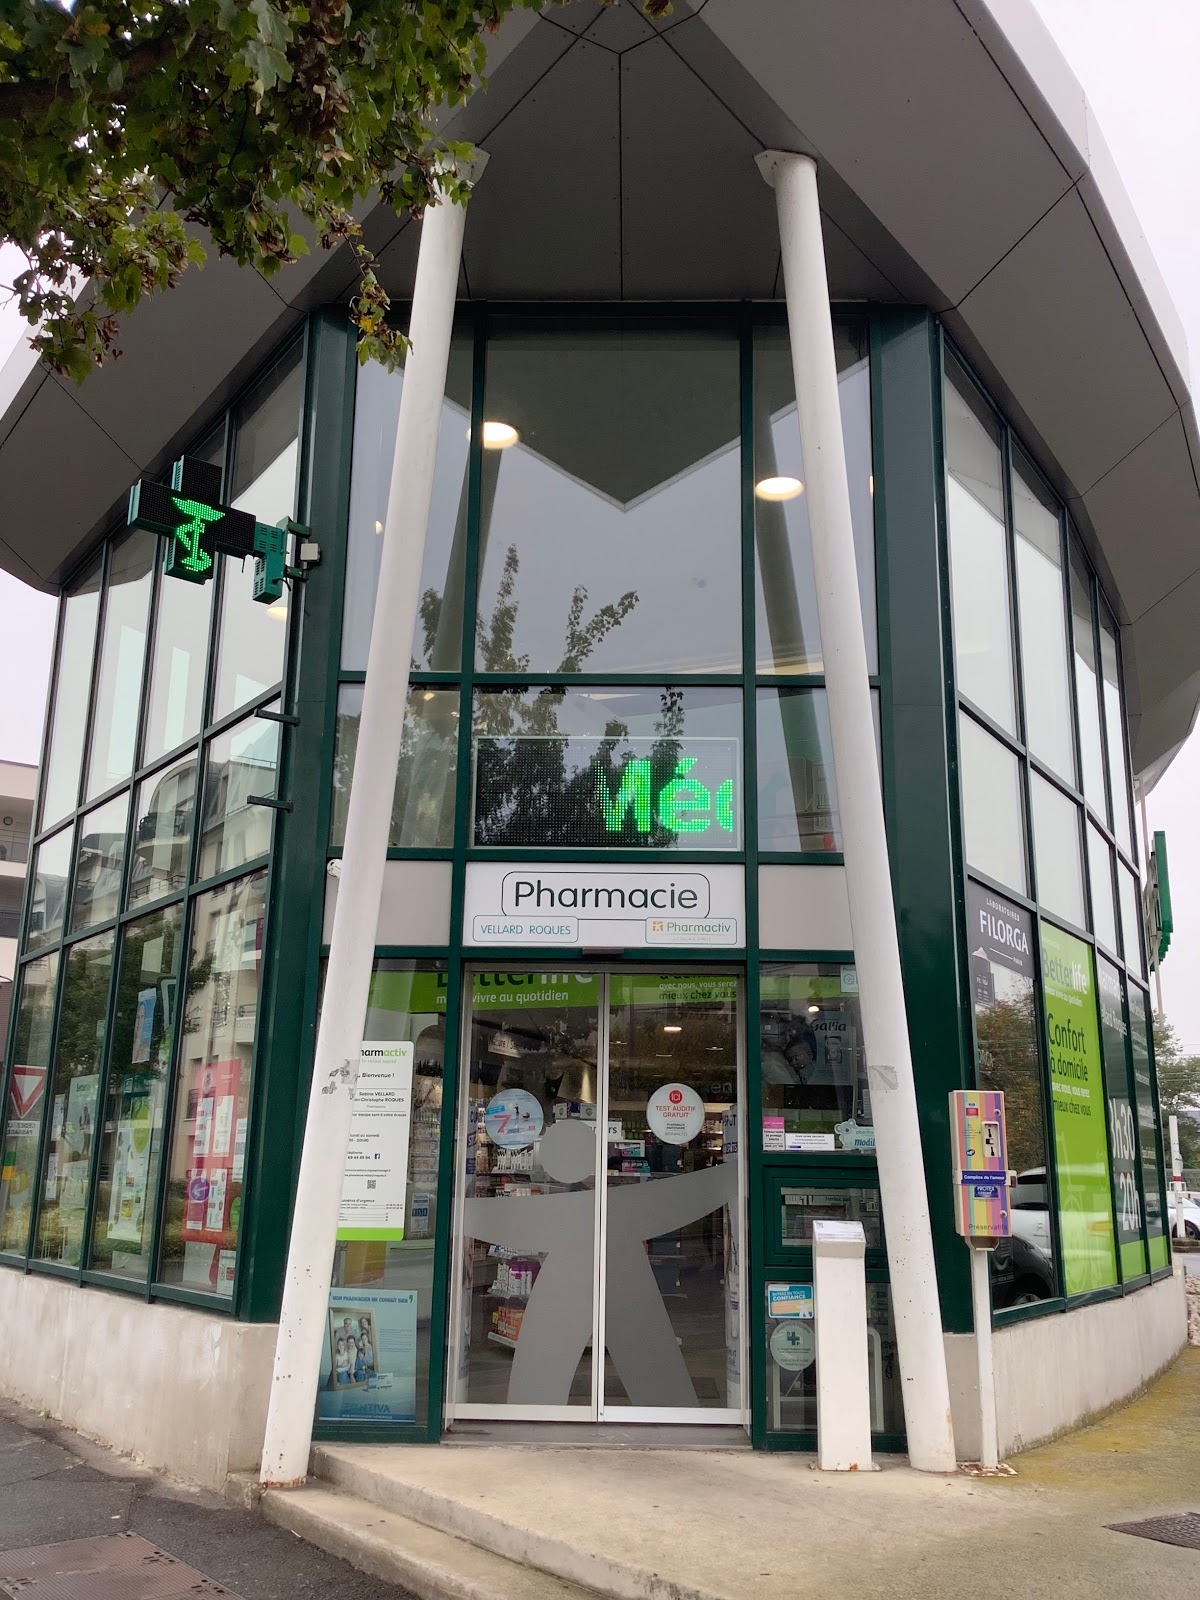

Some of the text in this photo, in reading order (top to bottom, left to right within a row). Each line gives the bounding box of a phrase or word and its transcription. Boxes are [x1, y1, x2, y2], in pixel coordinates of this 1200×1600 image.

[515, 880, 698, 909] Pharmacie
[986, 898, 1020, 921] LABORATOIRES
[481, 925, 571, 935] VELLARD ROQUES
[667, 922, 731, 933] Pharmactiv
[980, 910, 1029, 955] FILORGA
[472, 990, 569, 1004] vivre au quotidien
[659, 990, 737, 1000] mieux chez vous
[1047, 1013, 1086, 1054] Confort
[1050, 1050, 1088, 1081] à domicile
[1069, 1098, 1080, 1115] chez
[1080, 1105, 1092, 1116] vous
[1119, 1171, 1142, 1231] 20h
